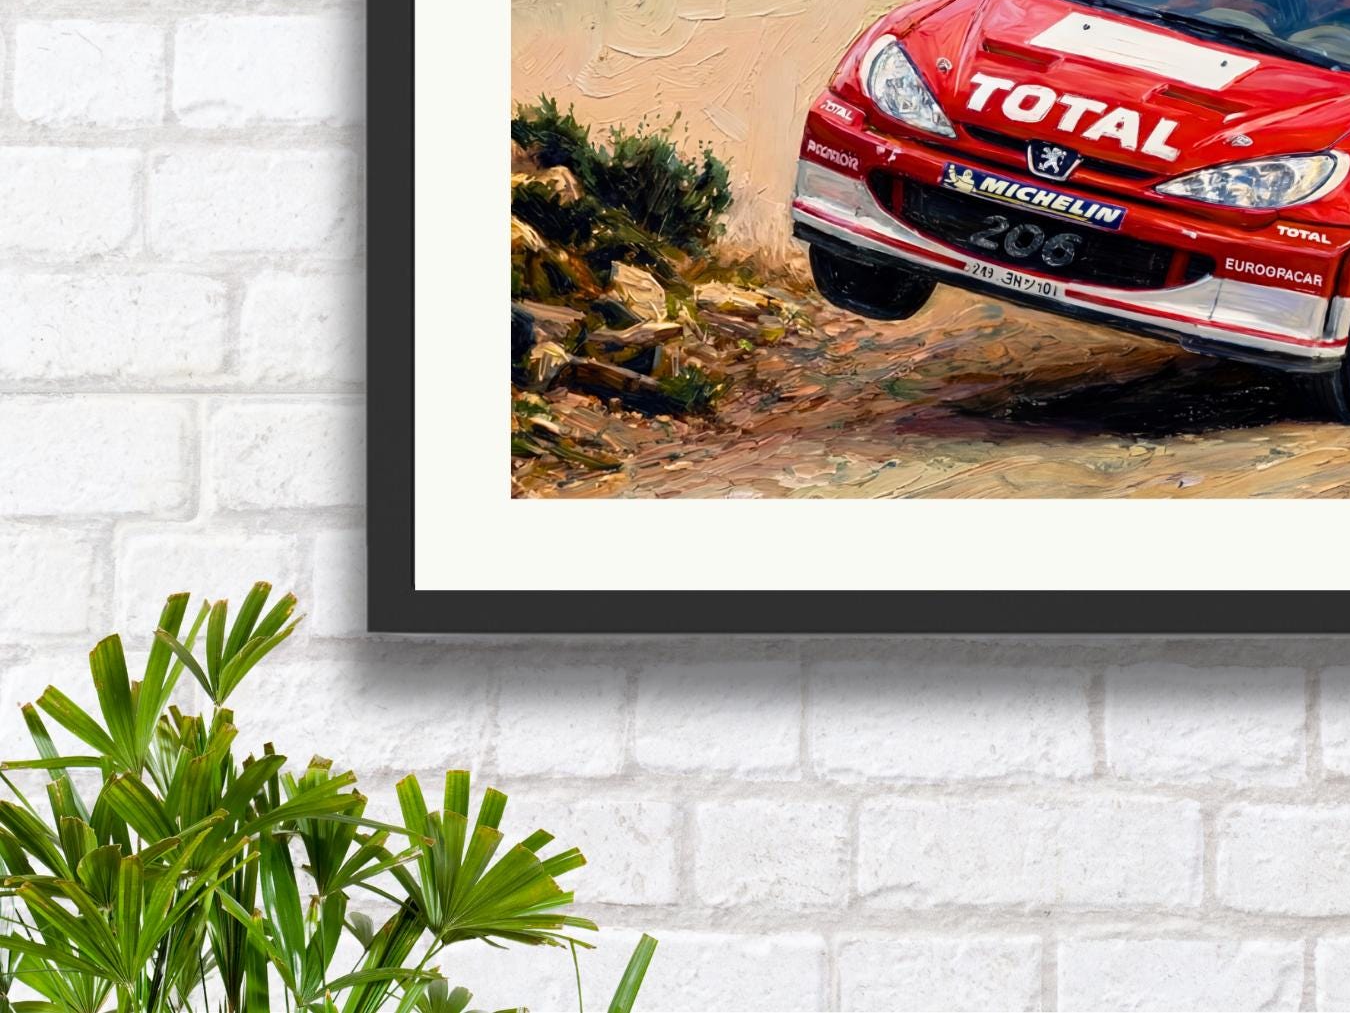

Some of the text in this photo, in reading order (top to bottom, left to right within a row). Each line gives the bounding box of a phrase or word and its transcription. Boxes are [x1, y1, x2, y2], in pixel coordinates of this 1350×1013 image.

[967, 72, 1181, 162] TOTAL
[979, 176, 1122, 223] MICHELIN
[970, 214, 1083, 267] 206
[1276, 225, 1332, 245] TOTAL
